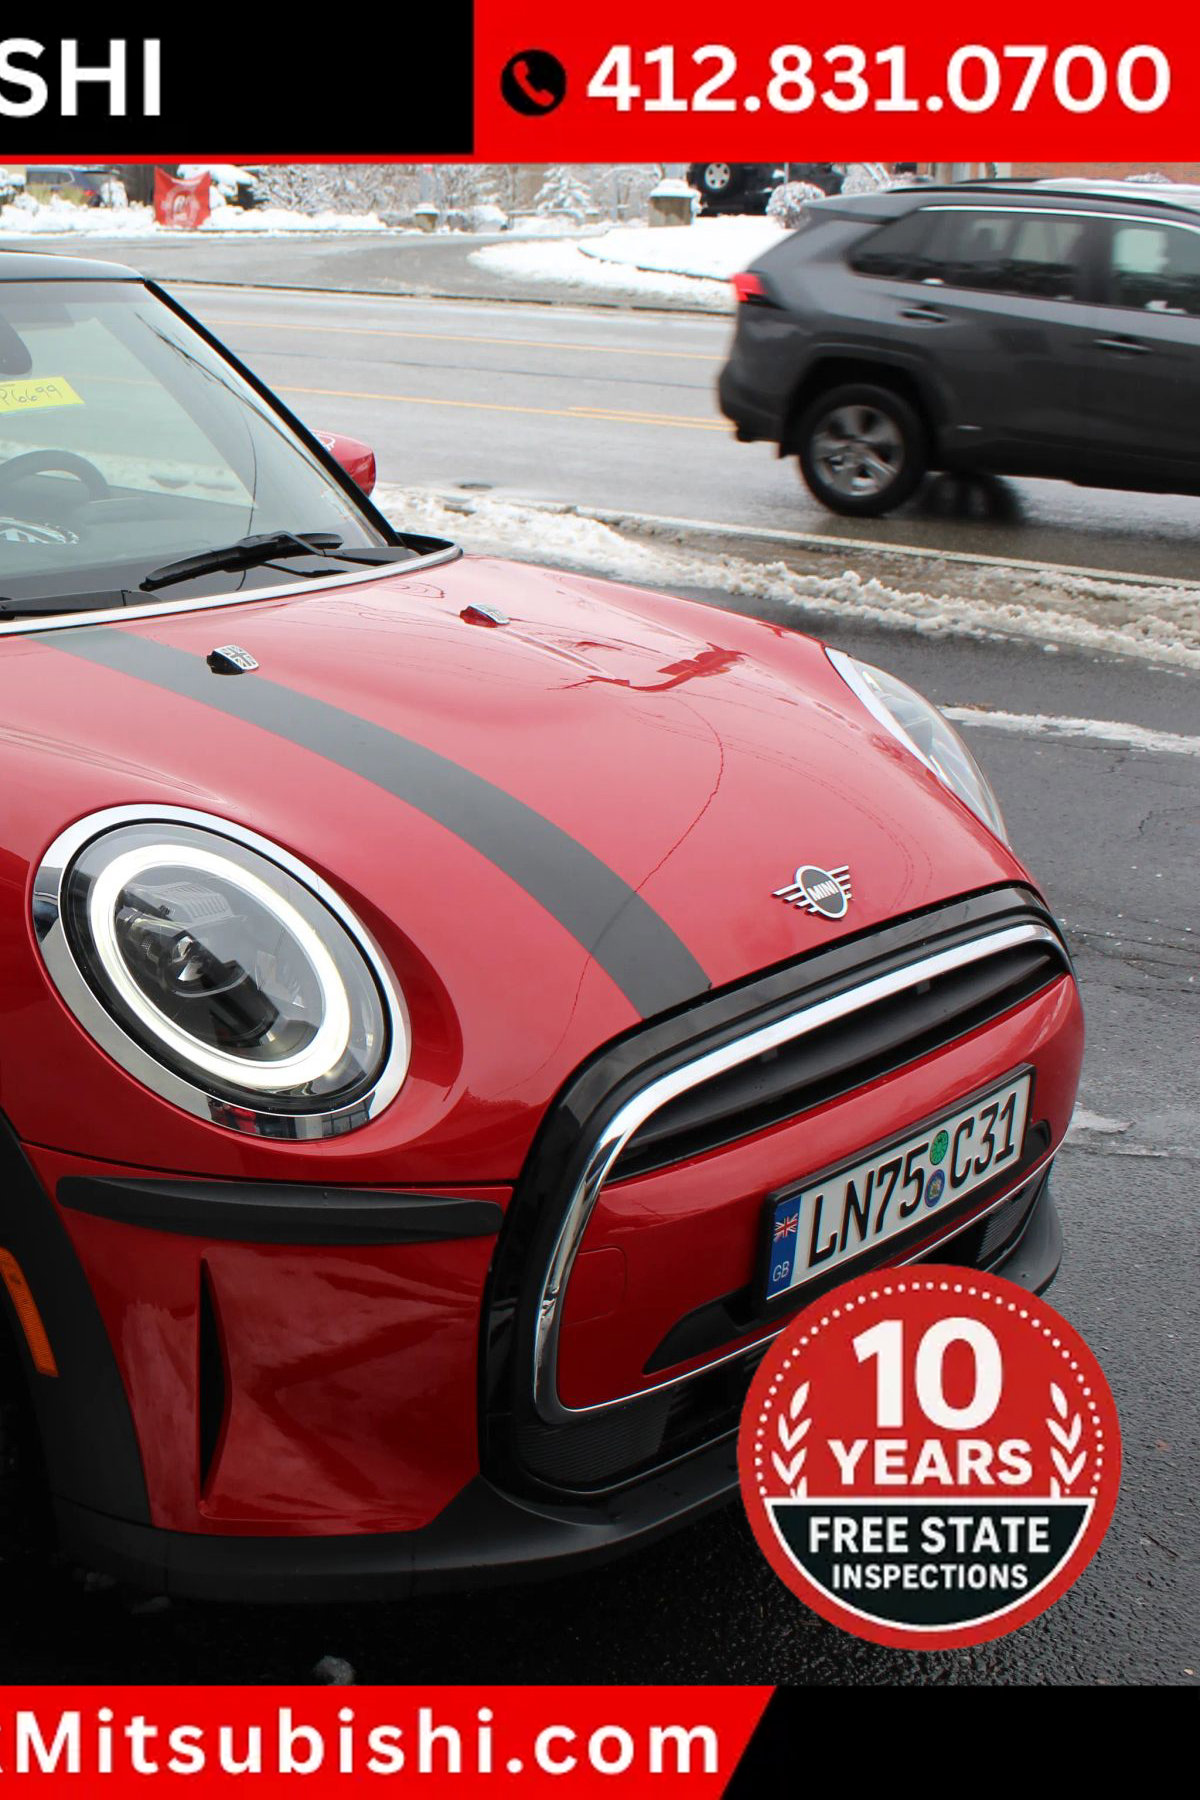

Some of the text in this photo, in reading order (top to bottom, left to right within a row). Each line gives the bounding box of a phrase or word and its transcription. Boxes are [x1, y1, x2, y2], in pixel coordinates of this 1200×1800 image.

[806, 879, 840, 902] MINI
[808, 1092, 1017, 1268] LN75 C31
[772, 1260, 790, 1282] GB
